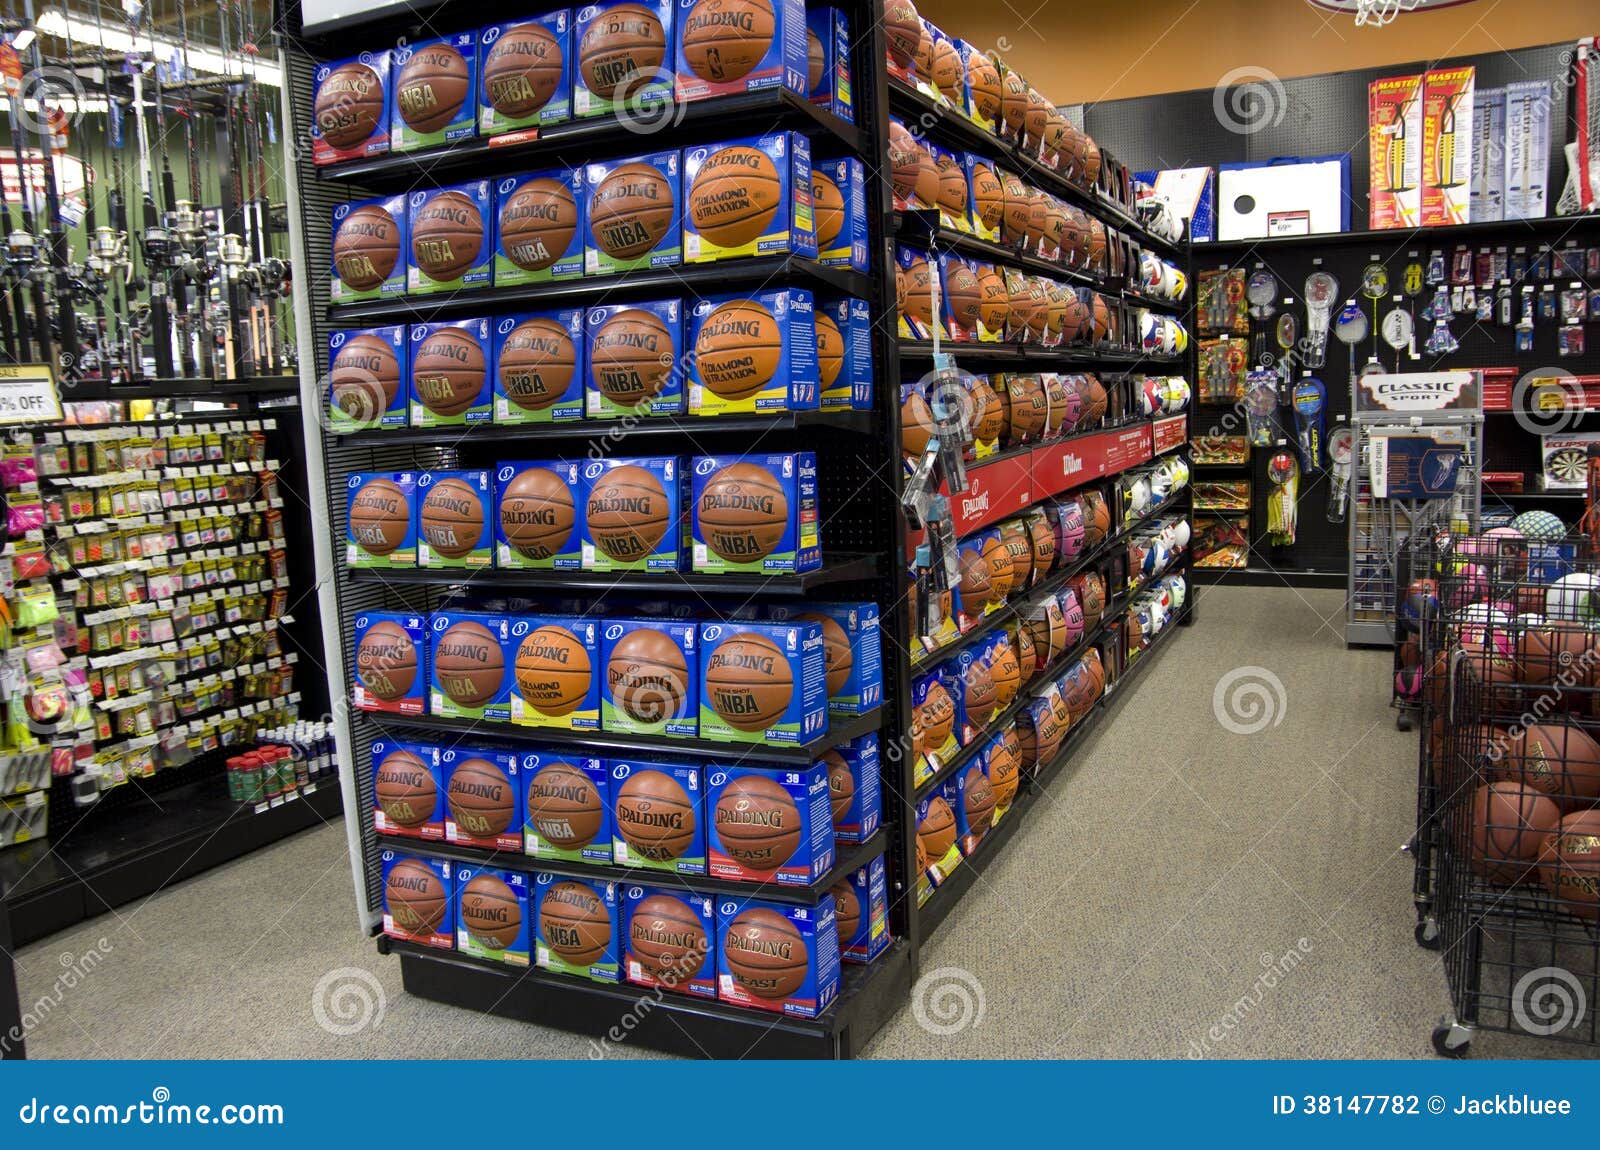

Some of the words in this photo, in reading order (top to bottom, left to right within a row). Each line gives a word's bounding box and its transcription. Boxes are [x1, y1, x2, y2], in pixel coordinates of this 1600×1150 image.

[593, 57, 641, 88] NBA
[1423, 116, 1435, 183] MASTER
[697, 154, 761, 177] PALDING
[703, 188, 747, 206] DIAMOND
[602, 223, 650, 249] NBA
[418, 241, 455, 264] NBA
[513, 241, 551, 264] NBA
[502, 338, 560, 355] PALDING
[707, 357, 753, 374] DIAMOND
[418, 376, 454, 400] NBA
[506, 374, 548, 396] NBA
[601, 372, 645, 394] NBA
[1378, 382, 1455, 393] CLASSIC
[19, 396, 43, 410] OFF
[588, 497, 652, 517] SPALDING
[701, 494, 775, 515] SPALDING
[962, 491, 989, 520] SPALDING
[502, 508, 556, 525] PALDING
[355, 527, 387, 545] NBA
[425, 527, 459, 547] NBA
[600, 535, 643, 556] NBA
[713, 534, 761, 556] NBA
[437, 644, 488, 663] PALDING
[518, 645, 569, 664] PALDING
[708, 654, 775, 675] SPALDING
[714, 692, 760, 715] NBA
[619, 804, 683, 829] SPALDING
[716, 807, 783, 828] SPALDING
[540, 820, 575, 838] NBA
[463, 906, 507, 923] PALDING
[549, 923, 581, 947] NBA
[632, 923, 698, 950] SPALDING
[727, 931, 792, 960] SPALDING
